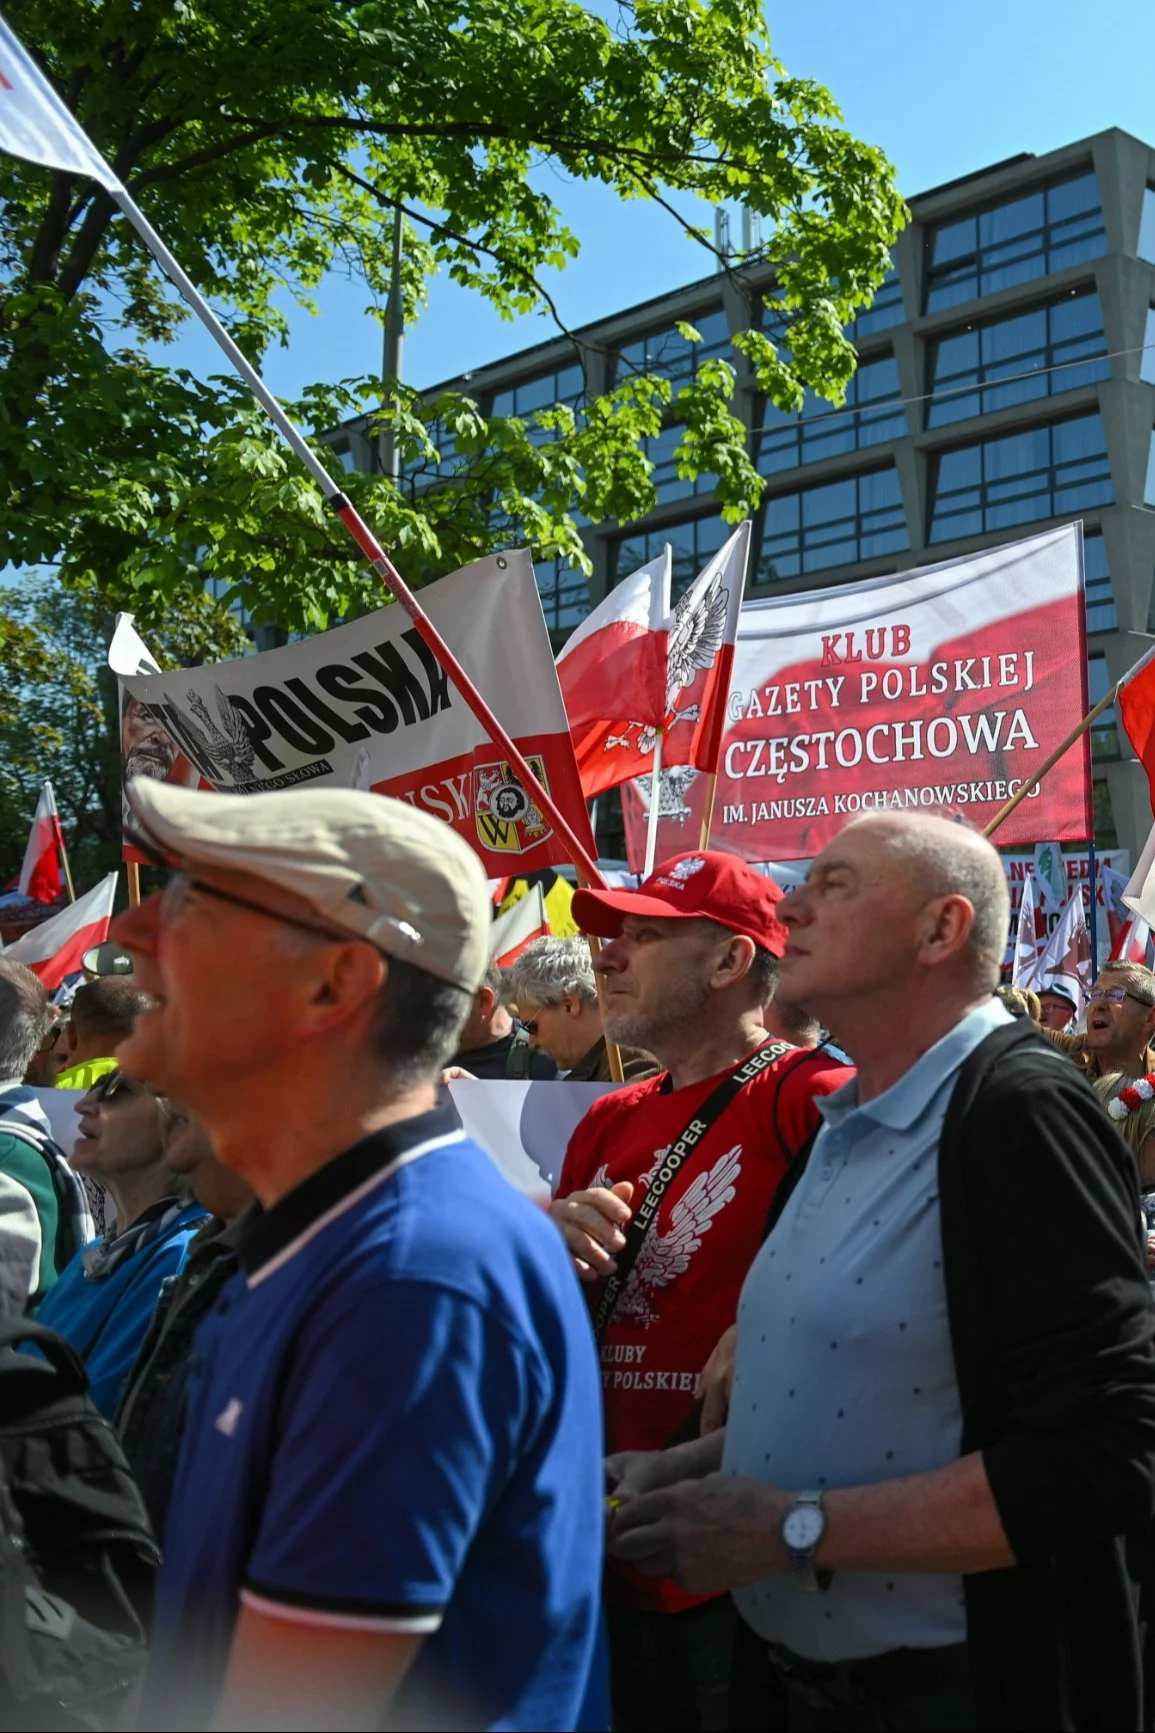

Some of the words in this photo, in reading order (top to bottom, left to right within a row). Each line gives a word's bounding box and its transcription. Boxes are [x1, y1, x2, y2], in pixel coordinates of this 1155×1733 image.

[821, 625, 911, 667] KLUB
[229, 628, 452, 772] POLSKA
[728, 676, 846, 722] GAZETY
[859, 650, 1036, 705] POLSKIEJ
[724, 708, 1040, 784] CZĘSTOCHOWA
[722, 804, 748, 824] IM.
[749, 796, 830, 827] JANUSZA
[834, 778, 1041, 815] KOCHANOWSKIEGO
[634, 1119, 708, 1231] LEECOOPER
[613, 1371, 703, 1399] POLSKIEJ
